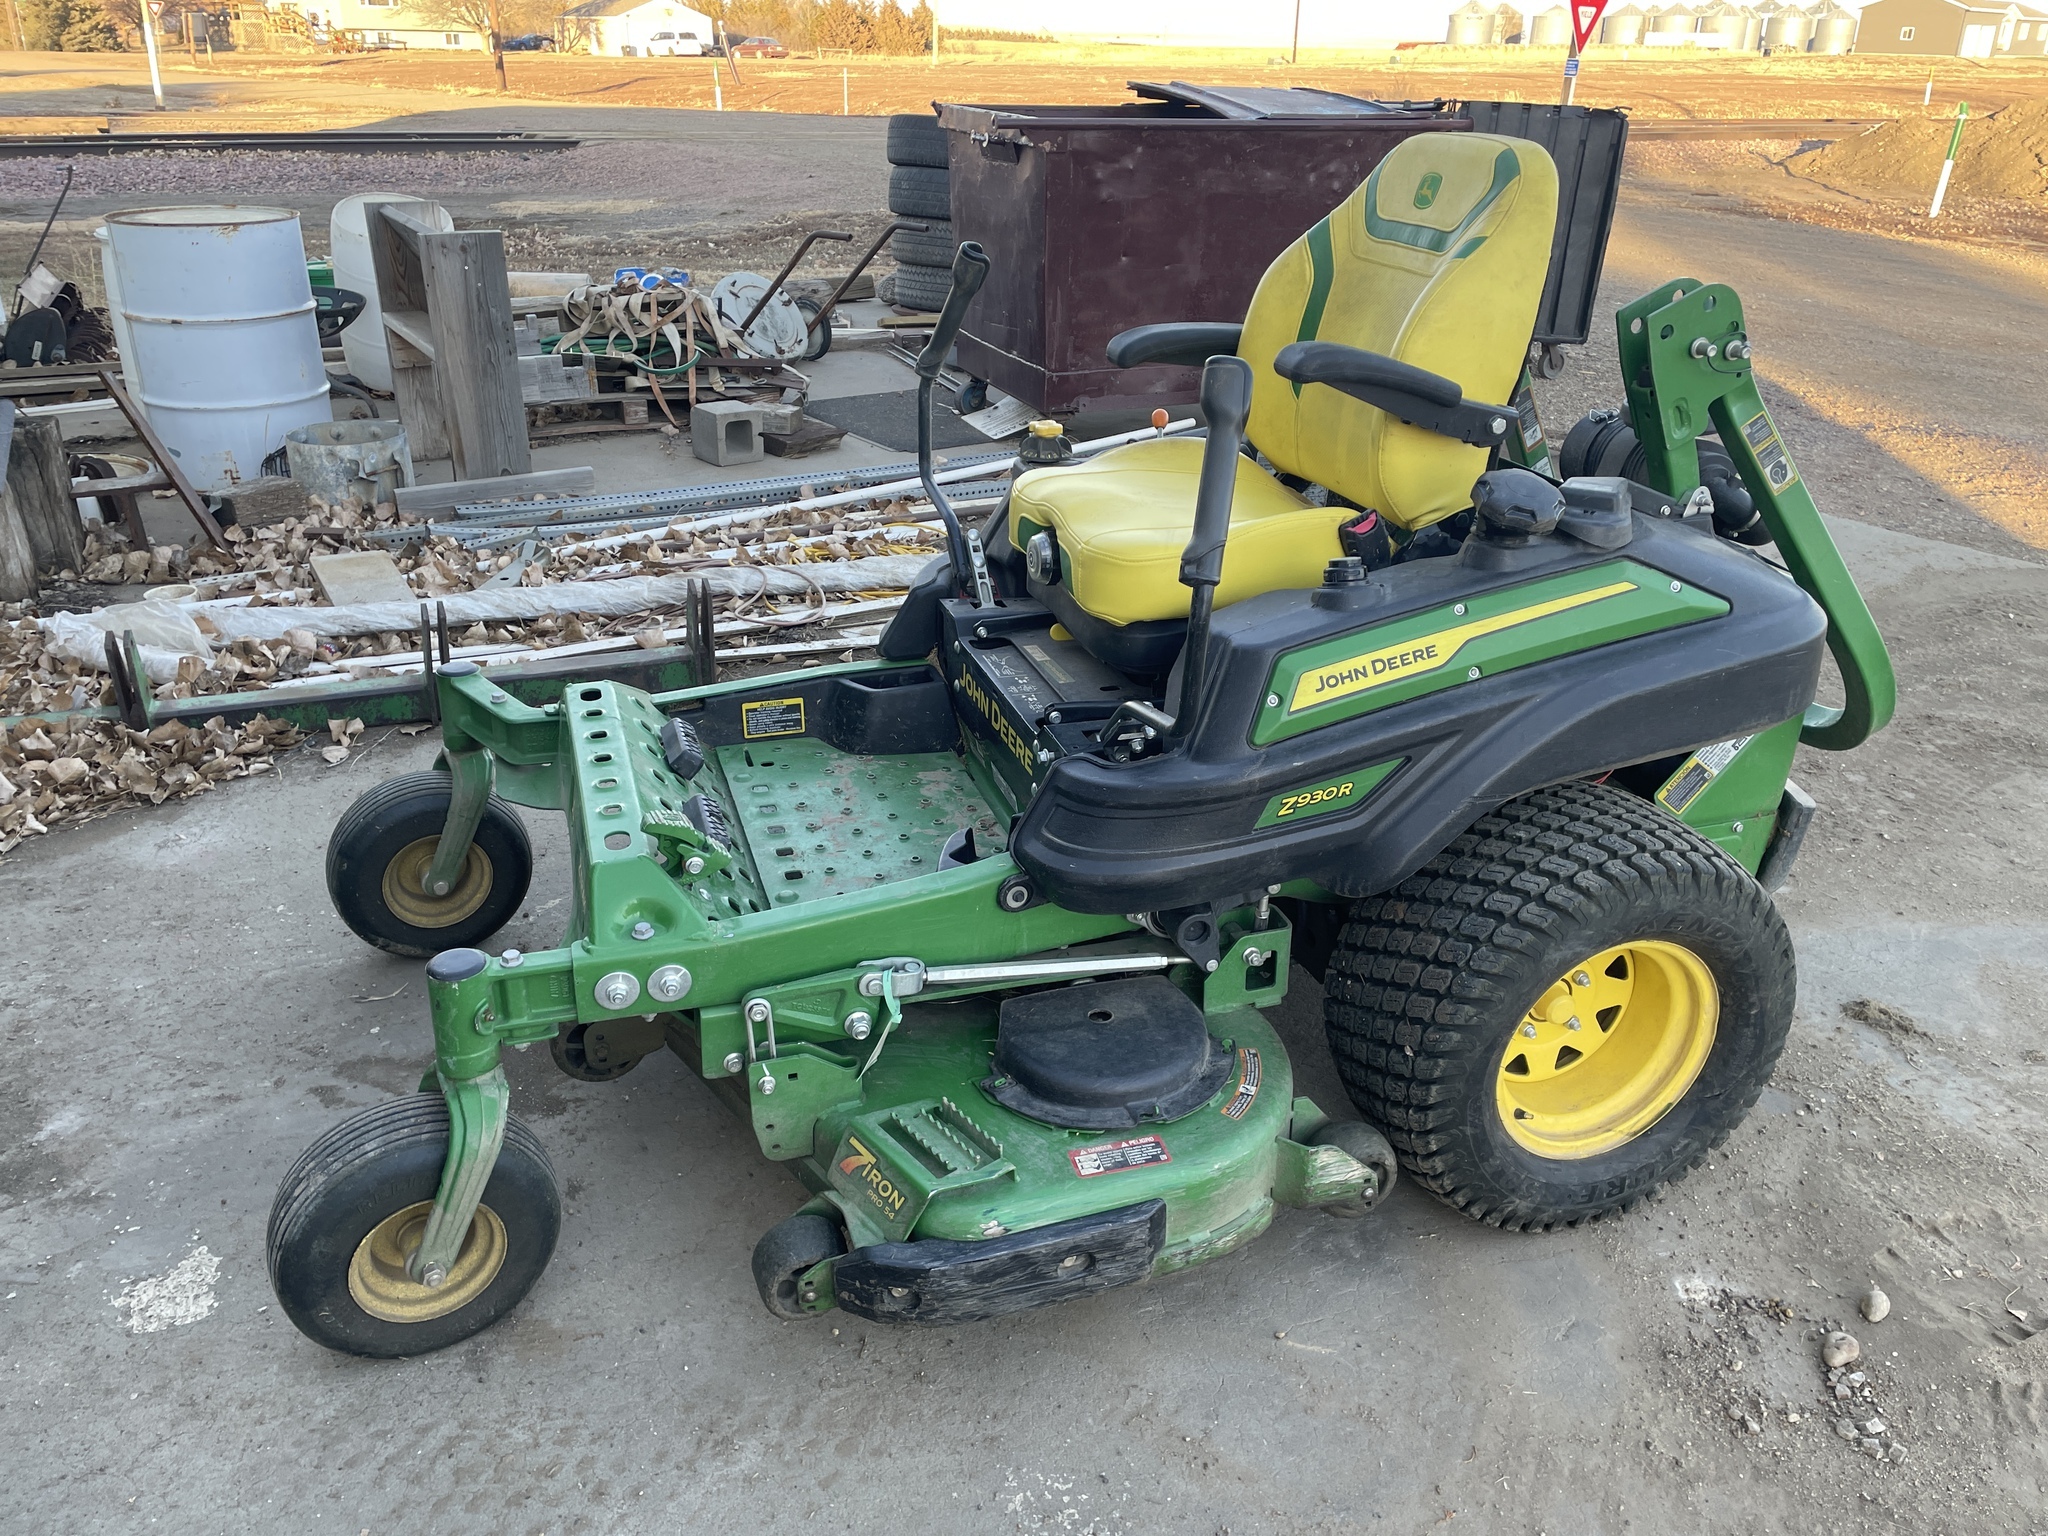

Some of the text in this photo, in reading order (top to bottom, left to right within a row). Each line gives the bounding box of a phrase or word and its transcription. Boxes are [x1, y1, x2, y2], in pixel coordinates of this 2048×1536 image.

[1315, 644, 1438, 693] JOHN DEERE
[959, 663, 1034, 776] JOHN DEERE
[1277, 782, 1354, 818] Z930R
[1087, 1144, 1113, 1154] DANGER
[1128, 1136, 1155, 1146] PELIGRO
[867, 1189, 895, 1220] PRO 54
